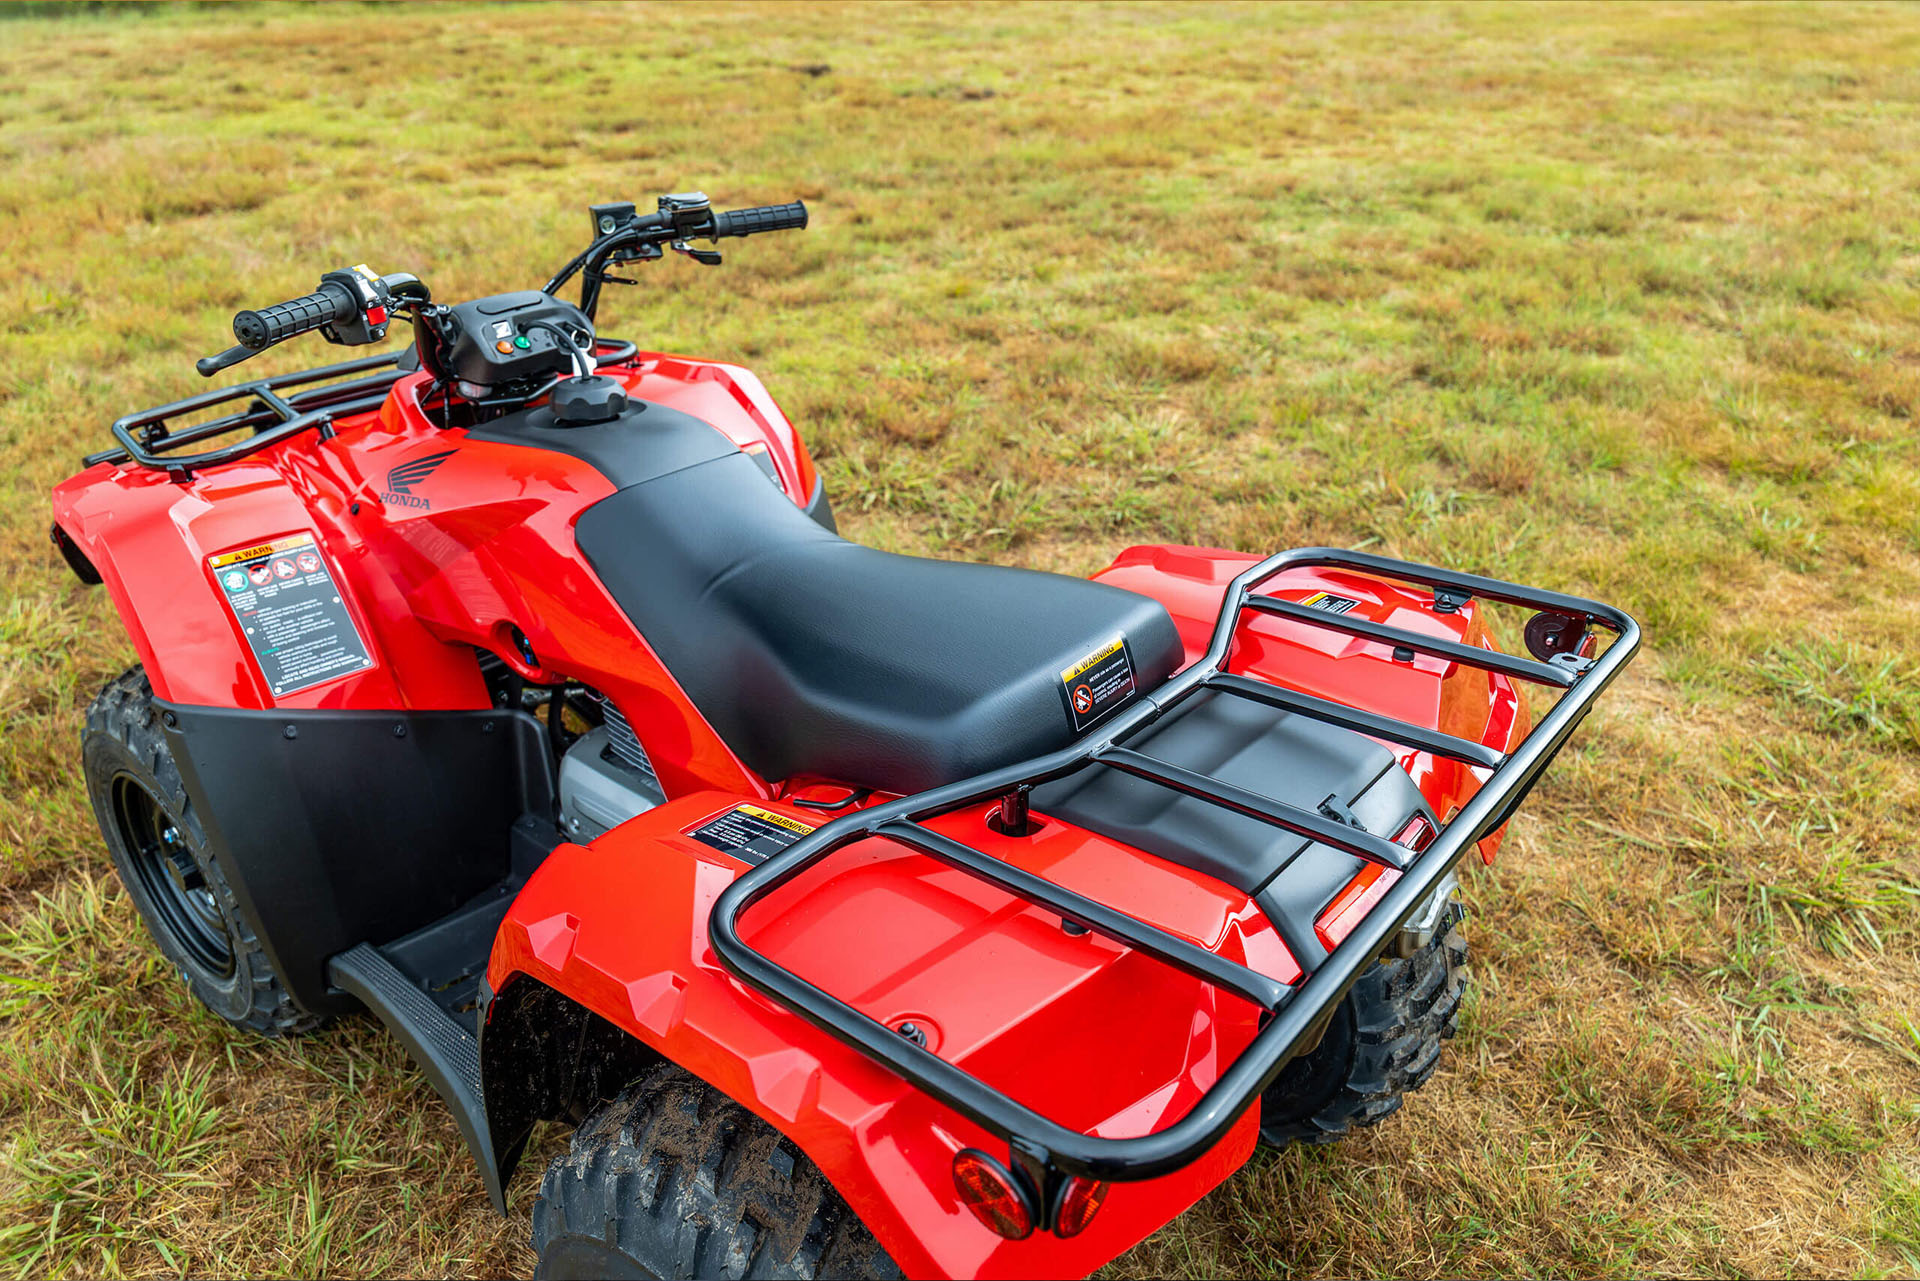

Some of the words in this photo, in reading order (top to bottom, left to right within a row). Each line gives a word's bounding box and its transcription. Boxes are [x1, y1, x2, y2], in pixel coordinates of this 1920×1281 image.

[380, 492, 431, 510] HONDA
[243, 541, 288, 558] WARNING
[1080, 643, 1114, 670] WARNING
[767, 814, 812, 834] WARNING
